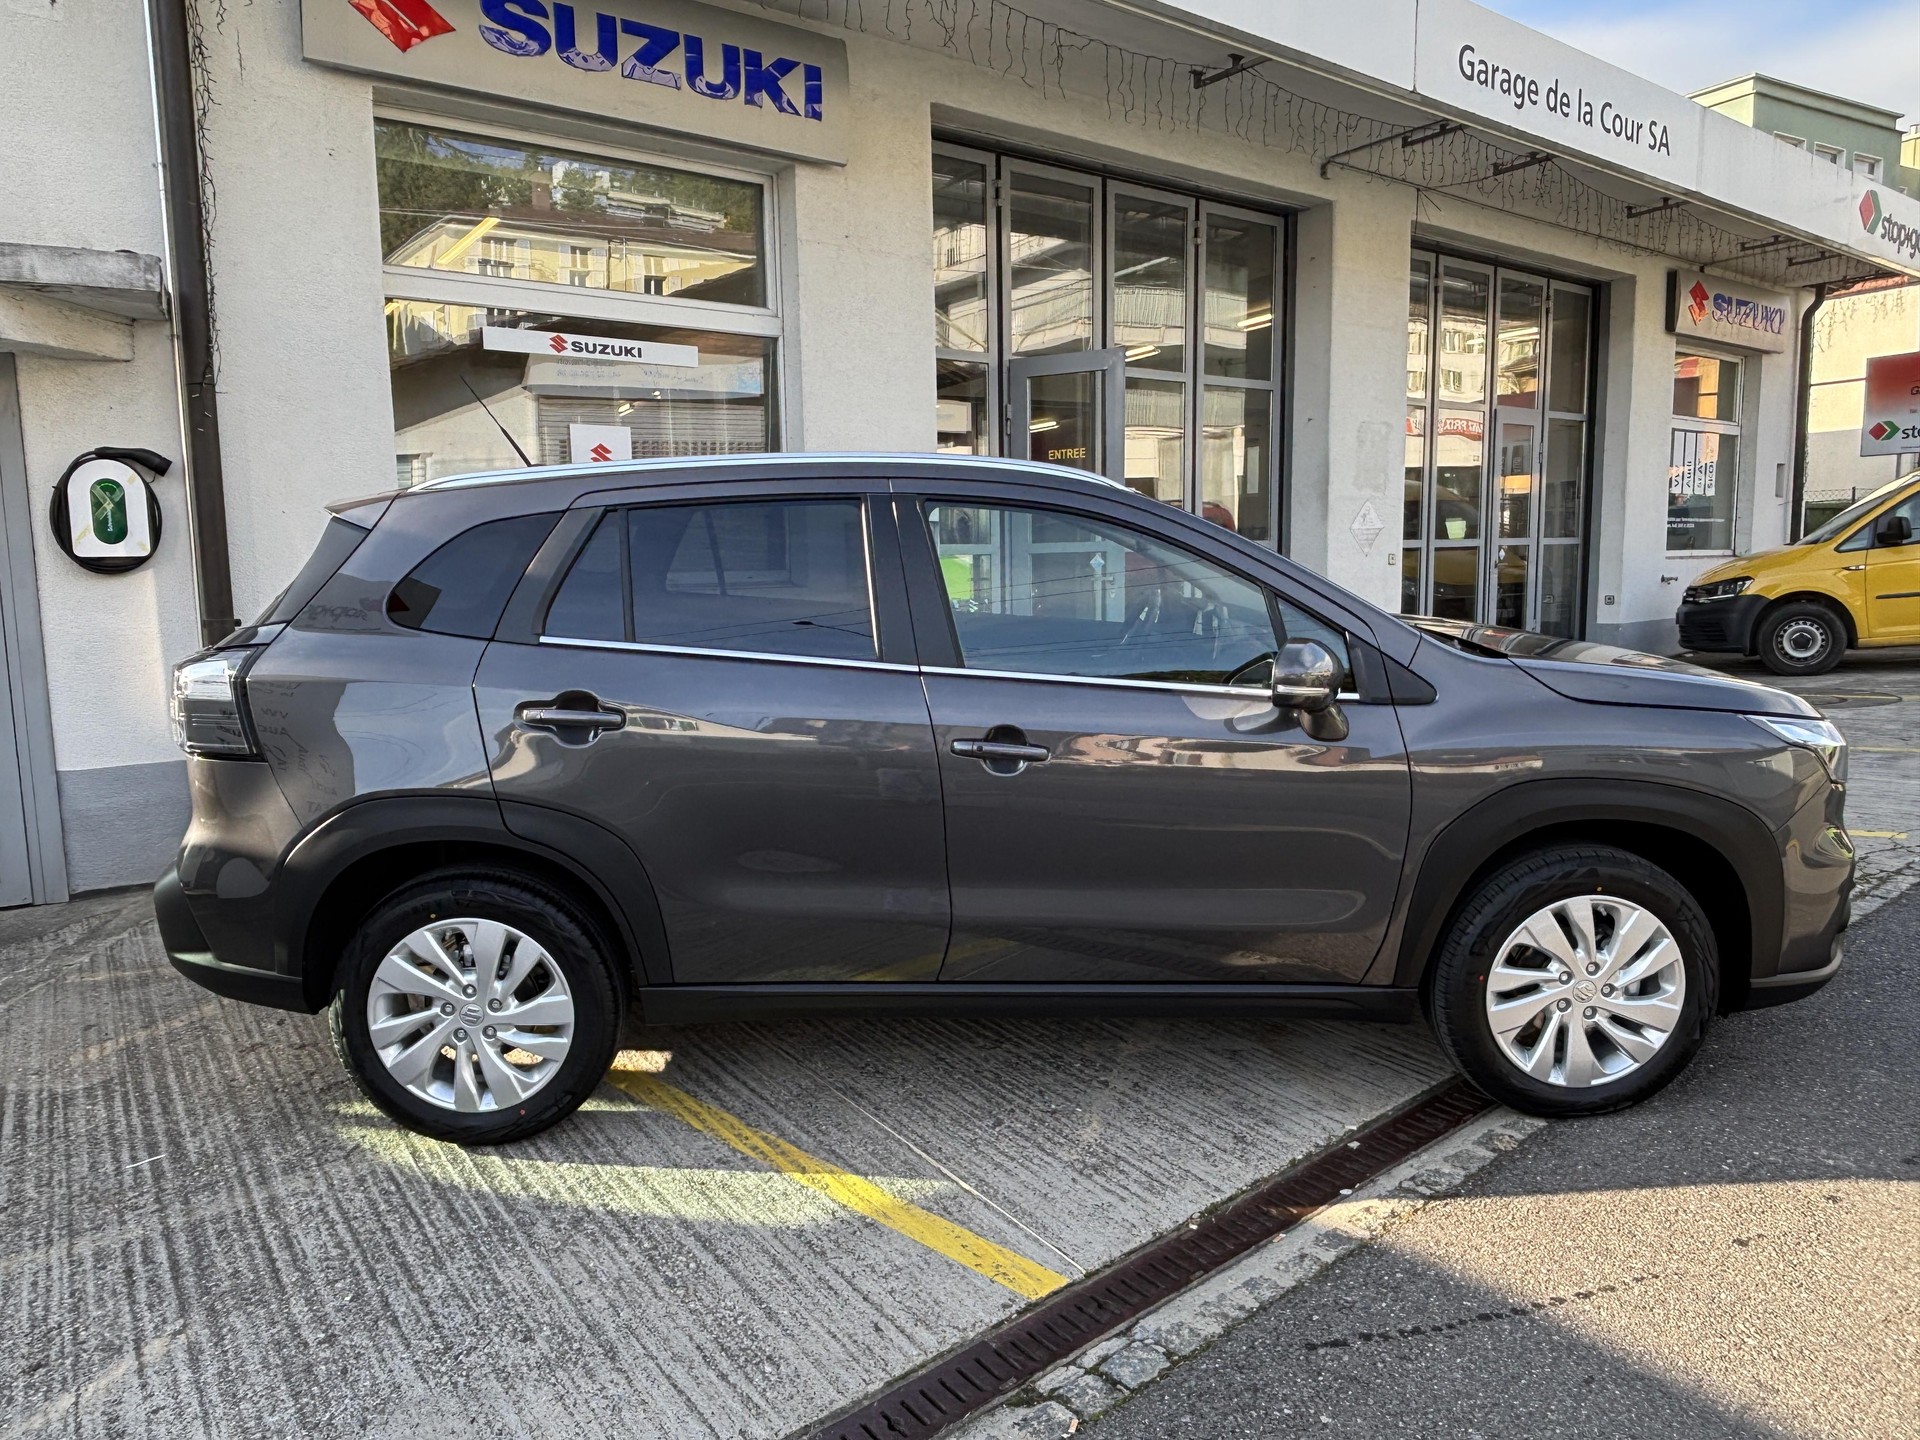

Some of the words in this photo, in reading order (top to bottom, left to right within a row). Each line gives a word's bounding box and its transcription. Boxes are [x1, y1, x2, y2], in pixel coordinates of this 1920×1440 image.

[478, 0, 823, 121] SUZUKI
[1458, 44, 1539, 110] Garage
[1546, 78, 1571, 118] de
[1577, 88, 1593, 128] la
[1600, 101, 1643, 145] Cour
[1648, 120, 1671, 157] SA
[571, 340, 642, 359] SUZUKI
[1048, 447, 1086, 460] ENTREE
